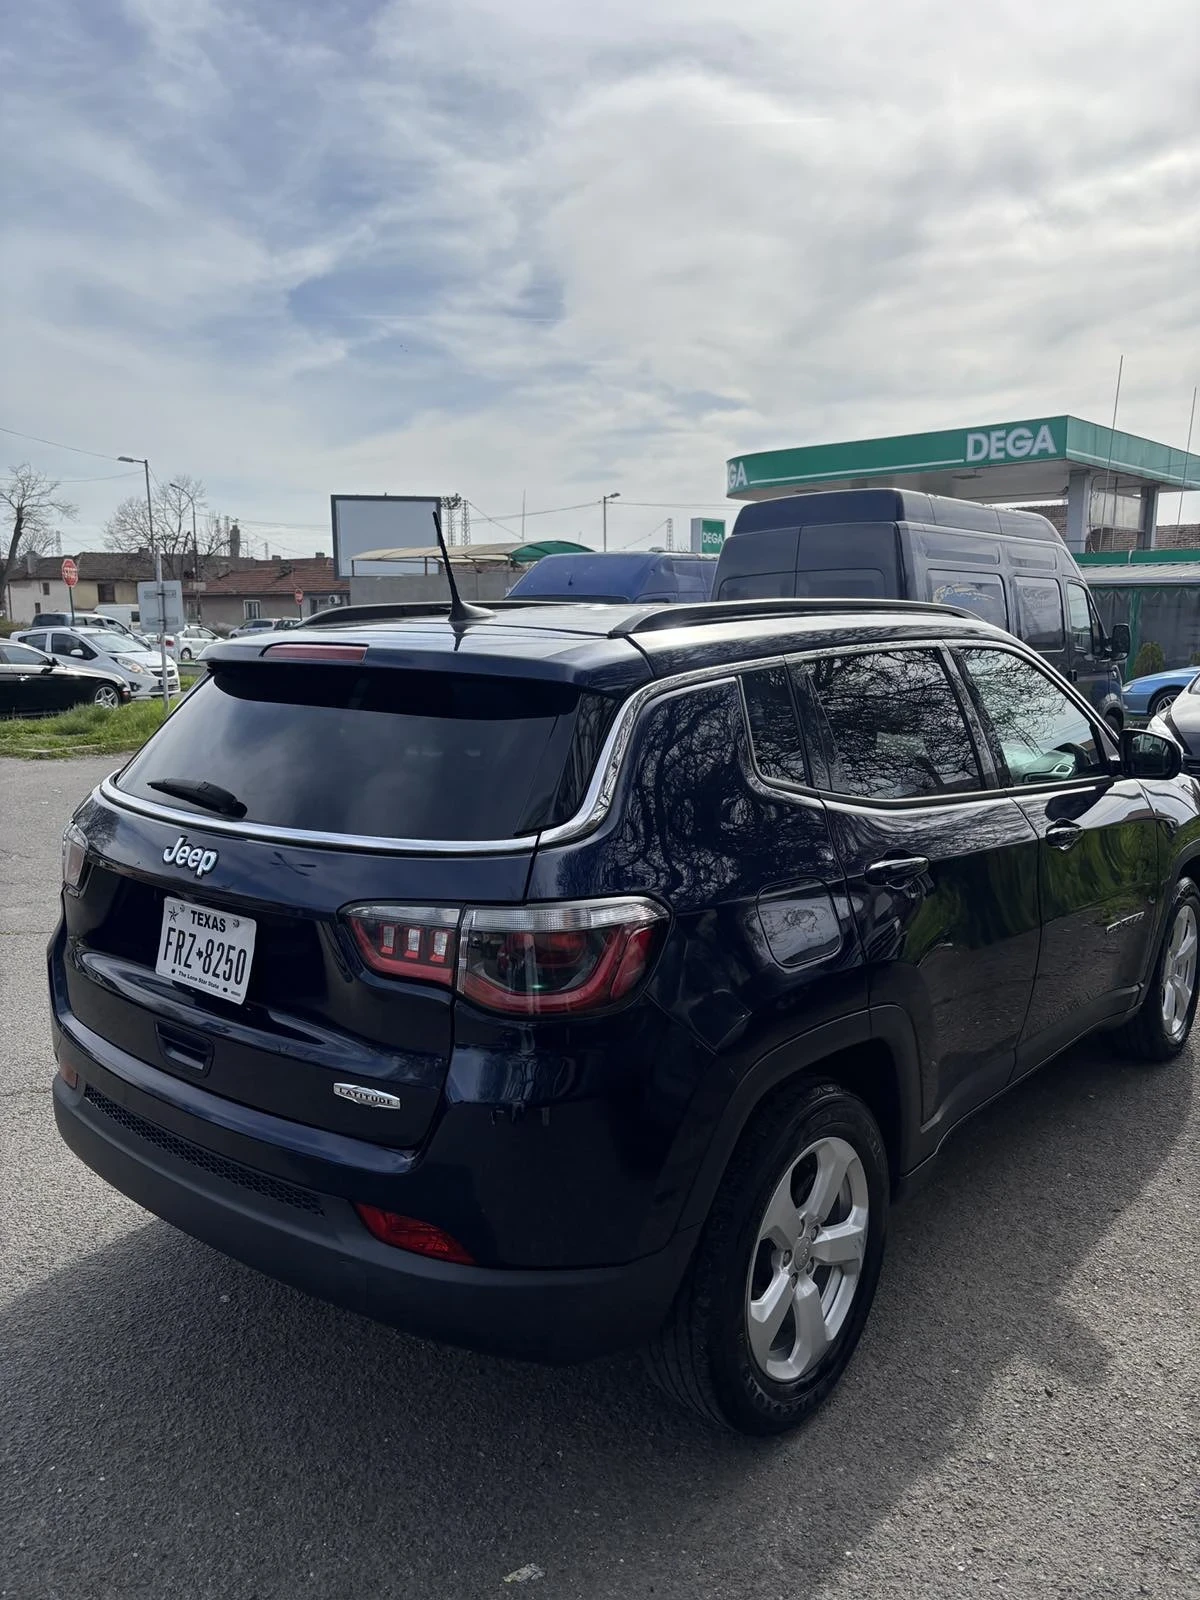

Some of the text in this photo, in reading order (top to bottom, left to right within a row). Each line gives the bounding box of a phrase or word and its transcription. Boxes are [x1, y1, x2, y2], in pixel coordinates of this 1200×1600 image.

[966, 425, 1057, 462] DEGA
[702, 532, 724, 545] DEGA
[163, 836, 218, 877] Jeep
[190, 909, 226, 933] TEXAS
[178, 970, 187, 978] The
[187, 974, 198, 982] Lone
[198, 977, 207, 985] Star
[339, 1087, 393, 1105] LATITUDE
